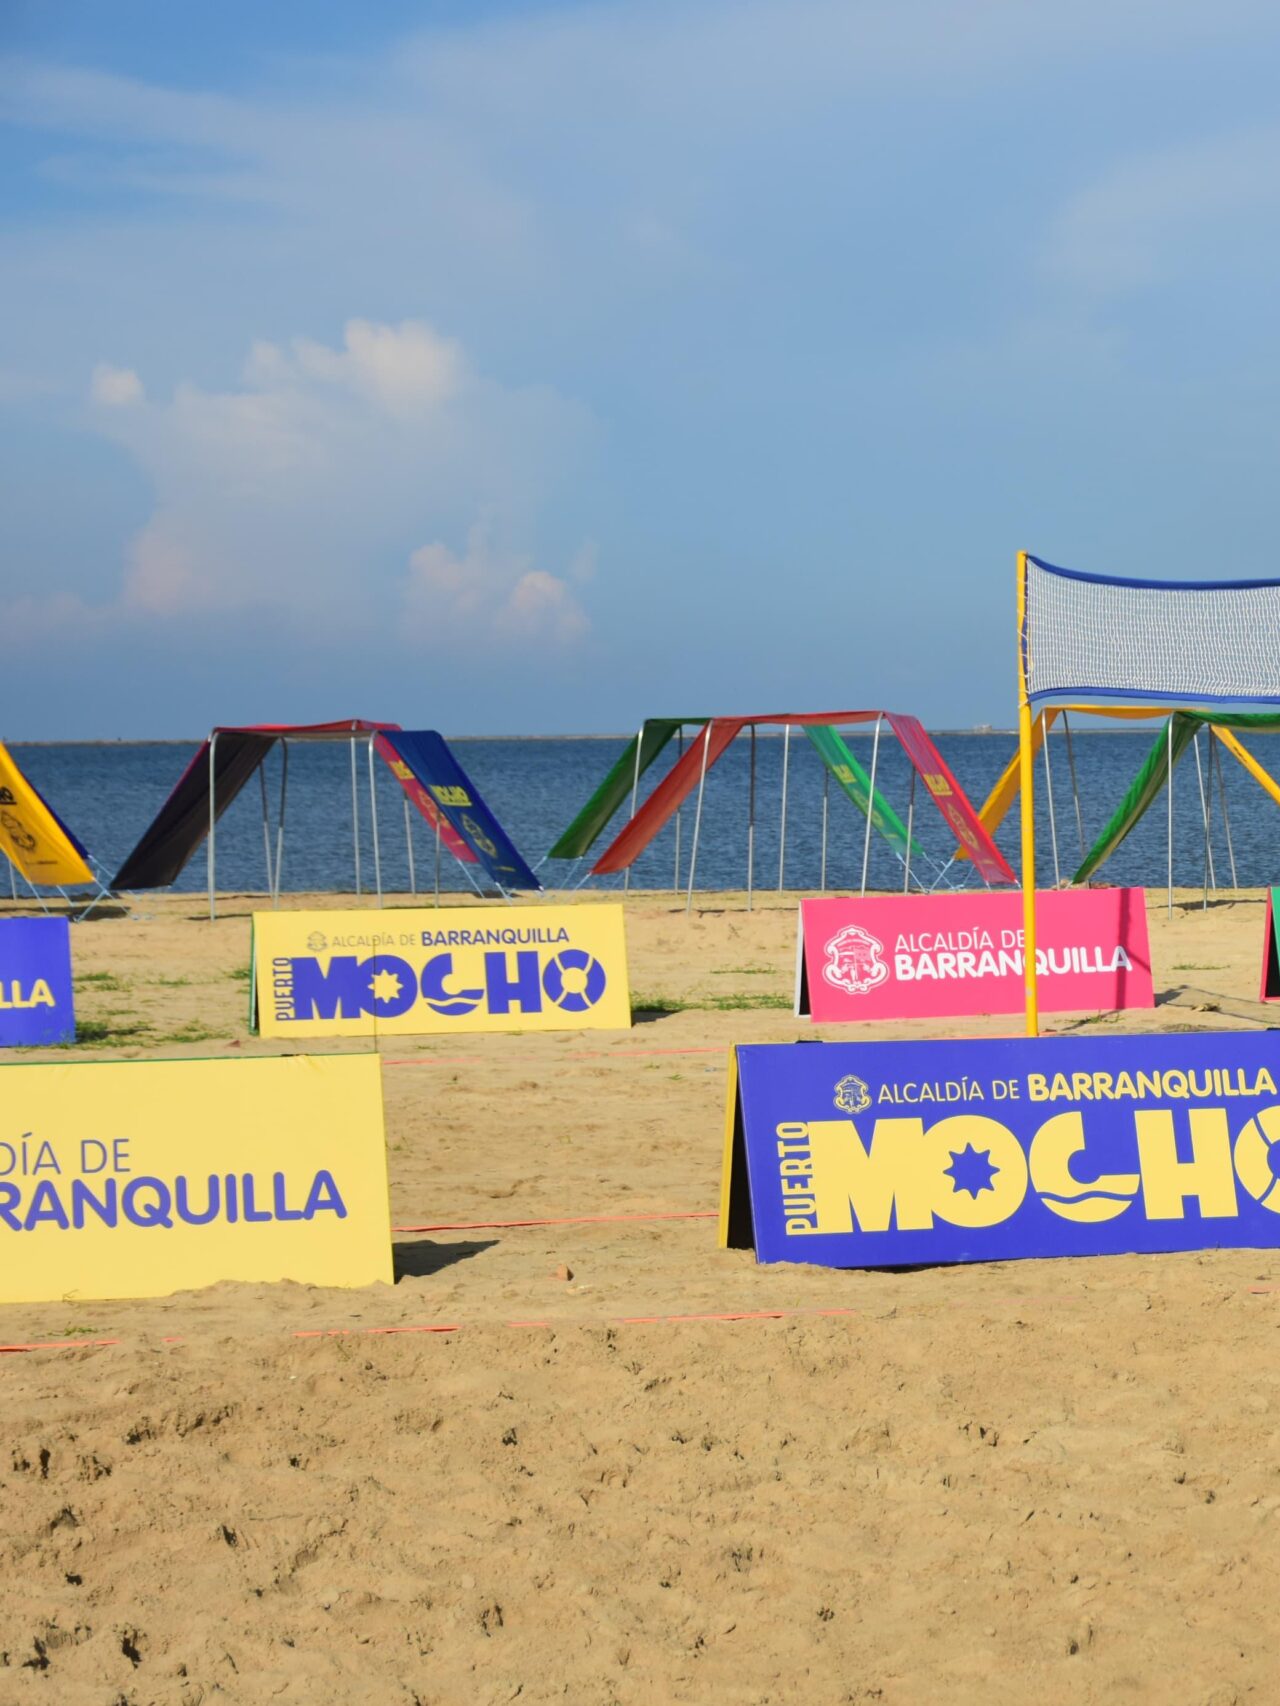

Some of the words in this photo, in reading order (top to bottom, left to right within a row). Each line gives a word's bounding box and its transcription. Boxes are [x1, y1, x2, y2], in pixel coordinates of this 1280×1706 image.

[332, 931, 395, 948] ALCALDÍA
[400, 934, 416, 946] DE
[421, 927, 570, 947] BARRANQUILLA
[895, 927, 994, 953] ALCALDÍA
[1001, 929, 1025, 949] DE
[895, 945, 1132, 981] BARRANQUILLA
[272, 957, 296, 1021] PUERTO
[291, 949, 606, 1020] MOCHO
[878, 1076, 984, 1104] ALCALDÍA
[992, 1079, 1020, 1100] DE
[1027, 1067, 1278, 1102] BARRANQUILLA
[80, 1138, 131, 1174] DE
[776, 1122, 817, 1235] PUERTO
